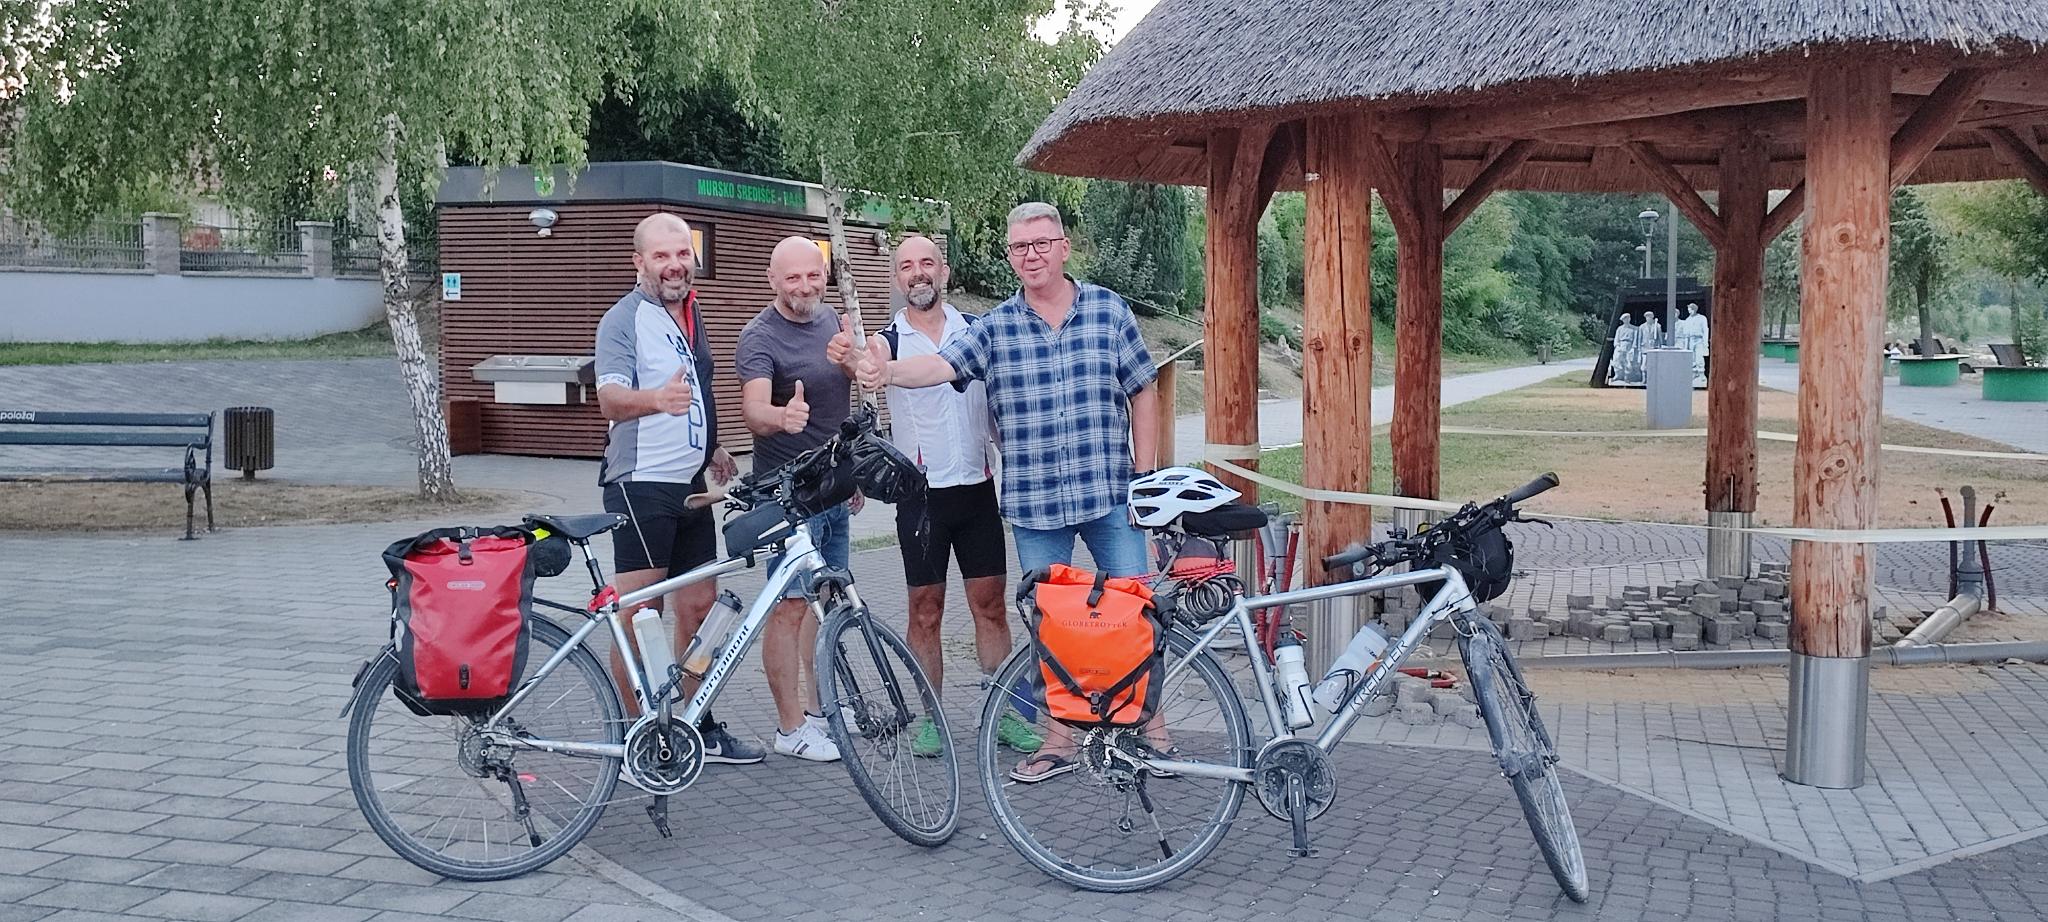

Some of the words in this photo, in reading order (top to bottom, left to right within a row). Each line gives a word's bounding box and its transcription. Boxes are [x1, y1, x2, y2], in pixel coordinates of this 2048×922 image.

[697, 179, 734, 199] MURSKO
[0, 410, 36, 422] položaj
[1349, 640, 1409, 712] KREIDLER
